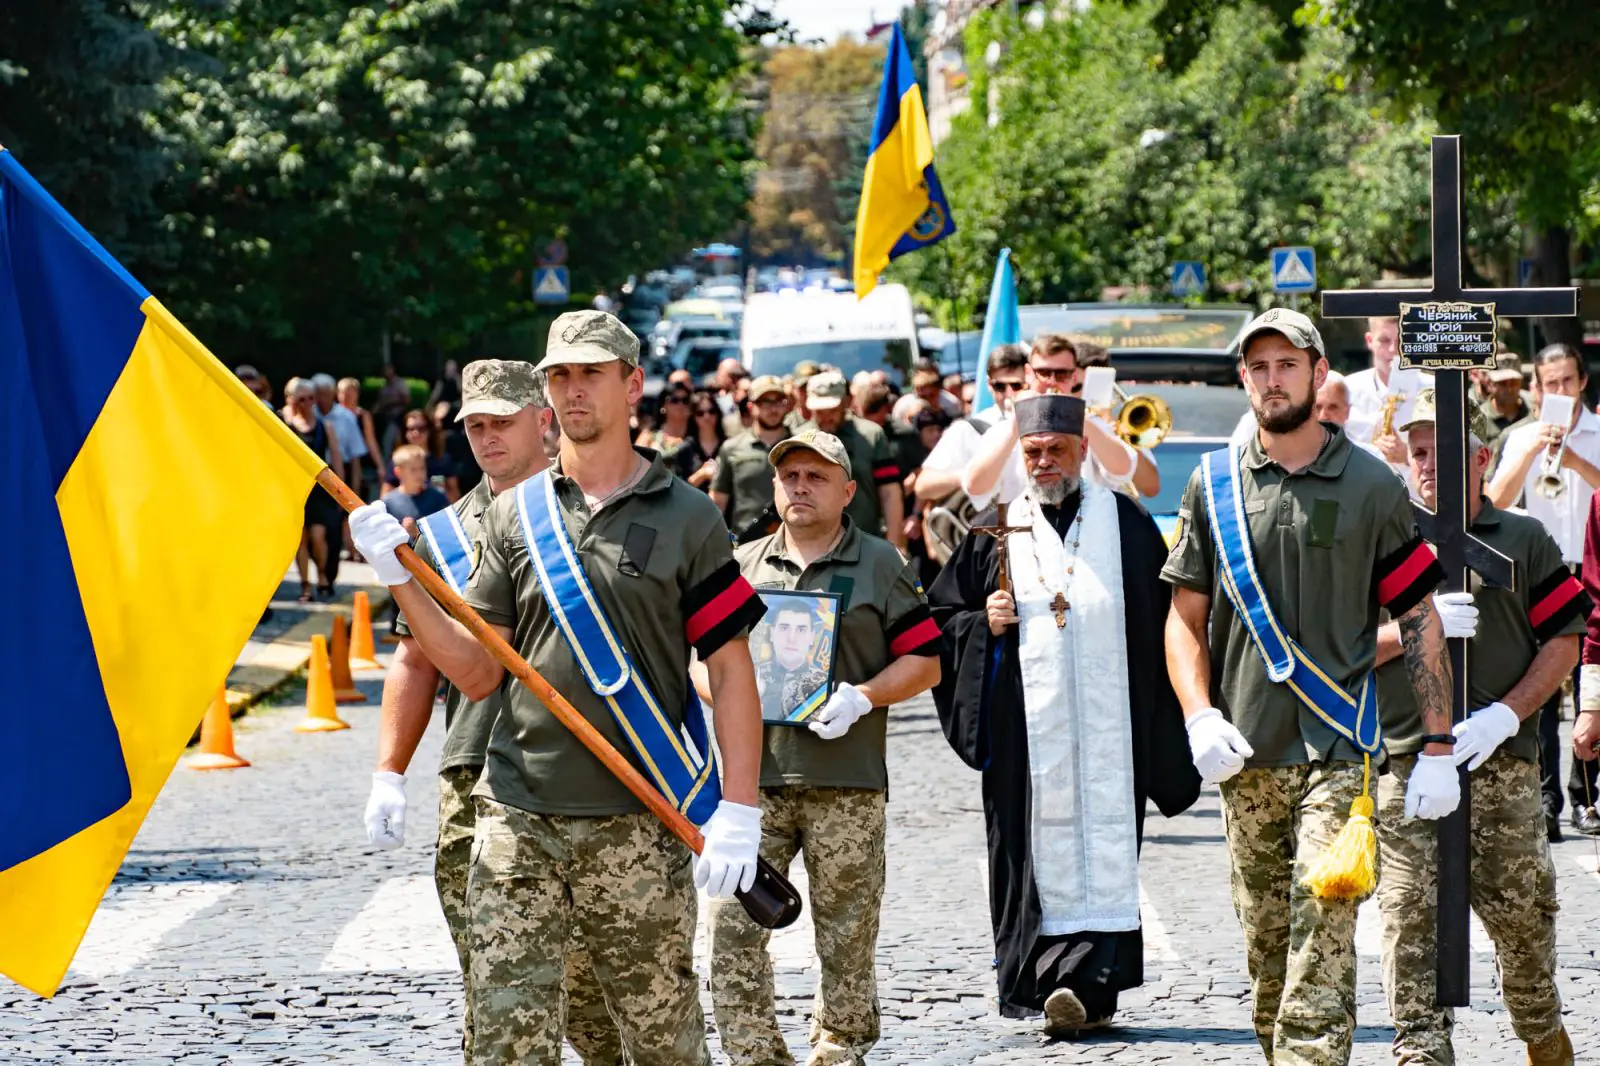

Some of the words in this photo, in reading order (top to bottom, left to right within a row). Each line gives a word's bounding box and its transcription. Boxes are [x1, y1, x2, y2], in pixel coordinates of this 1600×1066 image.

[1418, 310, 1478, 321] ЧЕРЯНИК
[1429, 322, 1462, 332] ЮРІЙ
[1416, 333, 1481, 342] ЮРІЙОВИЧ
